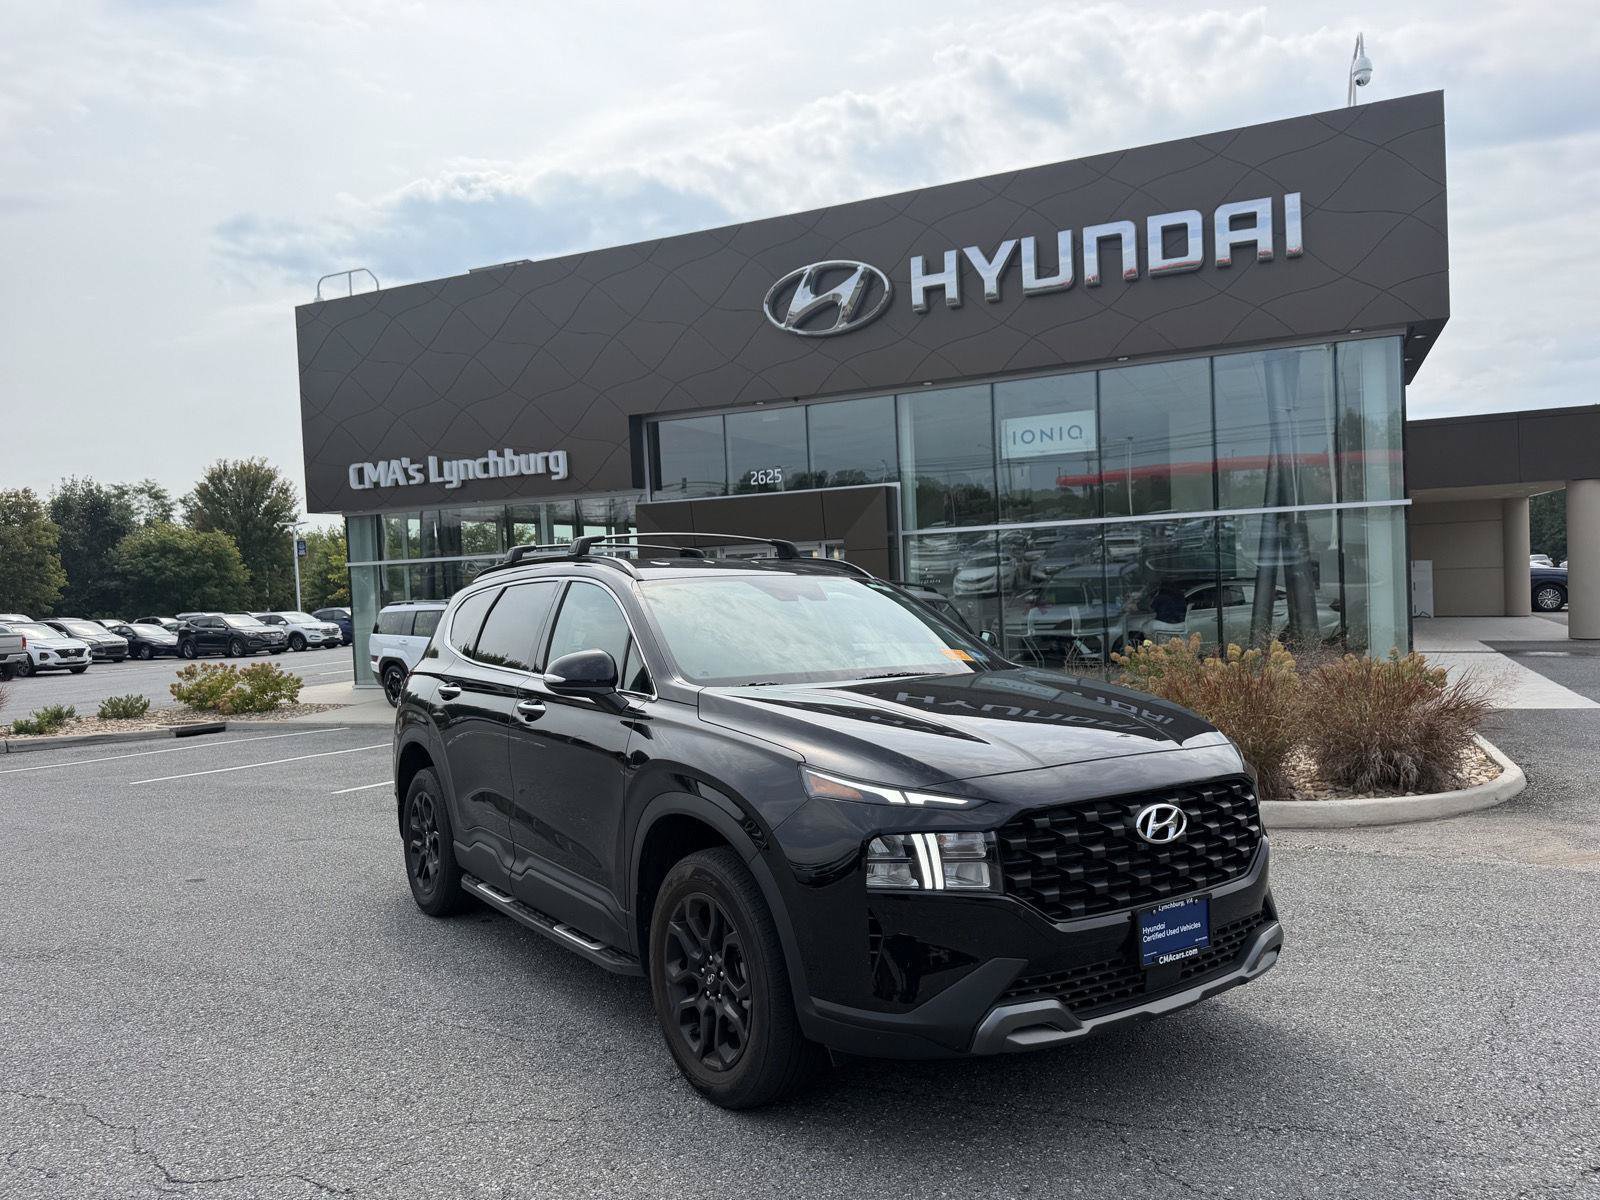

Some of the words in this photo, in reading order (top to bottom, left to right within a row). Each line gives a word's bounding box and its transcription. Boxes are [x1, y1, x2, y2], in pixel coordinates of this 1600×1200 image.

[909, 192, 1303, 314] HYUNDAI
[1012, 425, 1083, 445] IONIQ
[349, 456, 425, 490] CMA's
[427, 448, 568, 489] Lynchburg
[749, 468, 782, 486] 2625
[1142, 922, 1165, 934] Hyundai
[1142, 931, 1165, 942] Certified
[1166, 927, 1179, 936] Used
[1180, 922, 1201, 932] Vehicles
[1158, 948, 1198, 964] CMAcars.com
